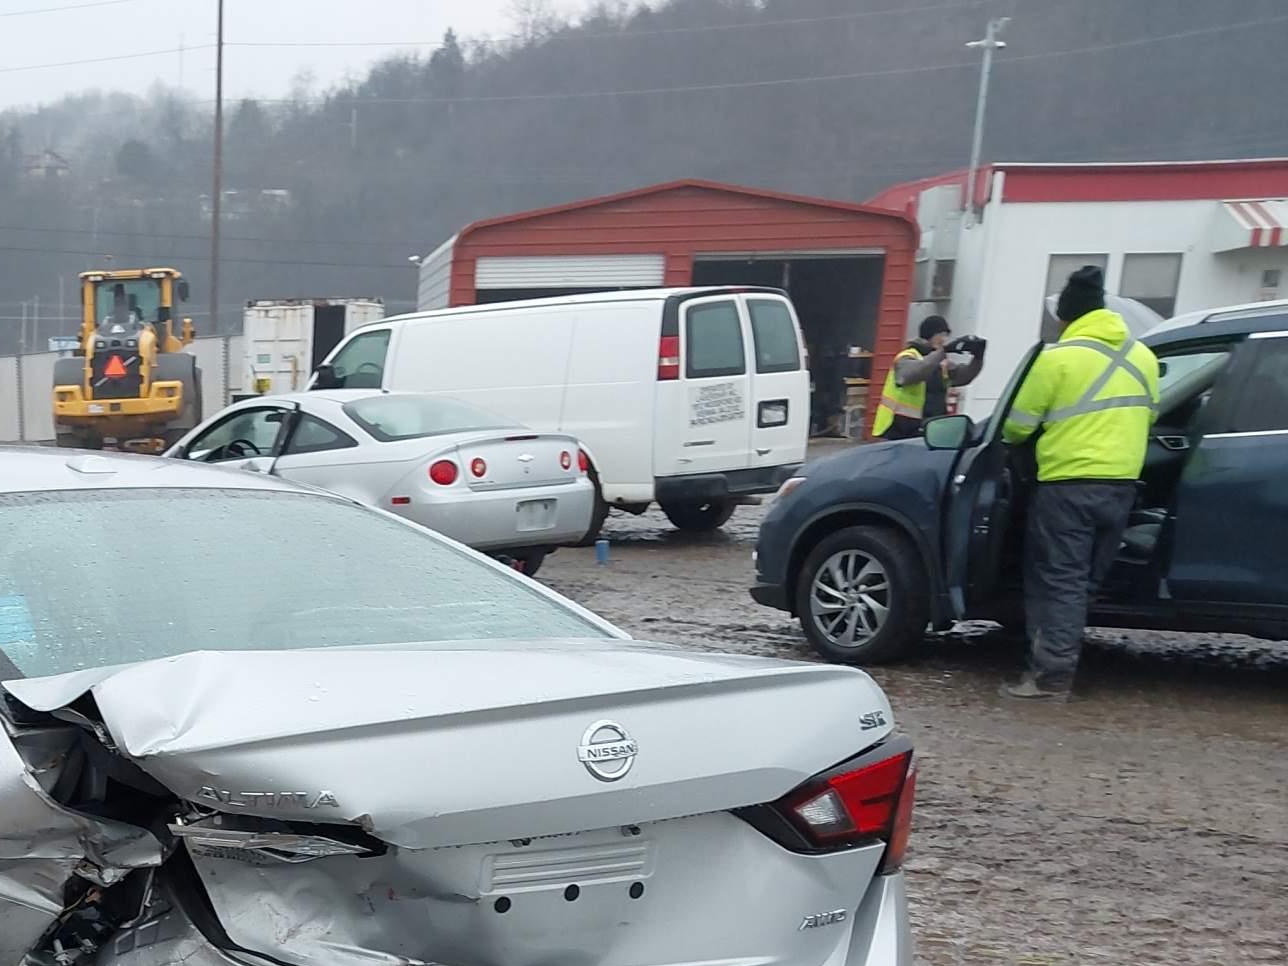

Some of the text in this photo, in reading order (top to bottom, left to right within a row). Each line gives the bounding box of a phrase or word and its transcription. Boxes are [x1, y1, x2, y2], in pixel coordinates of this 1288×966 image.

[587, 743, 635, 758] NISSAN
[197, 786, 340, 809] ALTIMA
[799, 908, 847, 930] AWD
